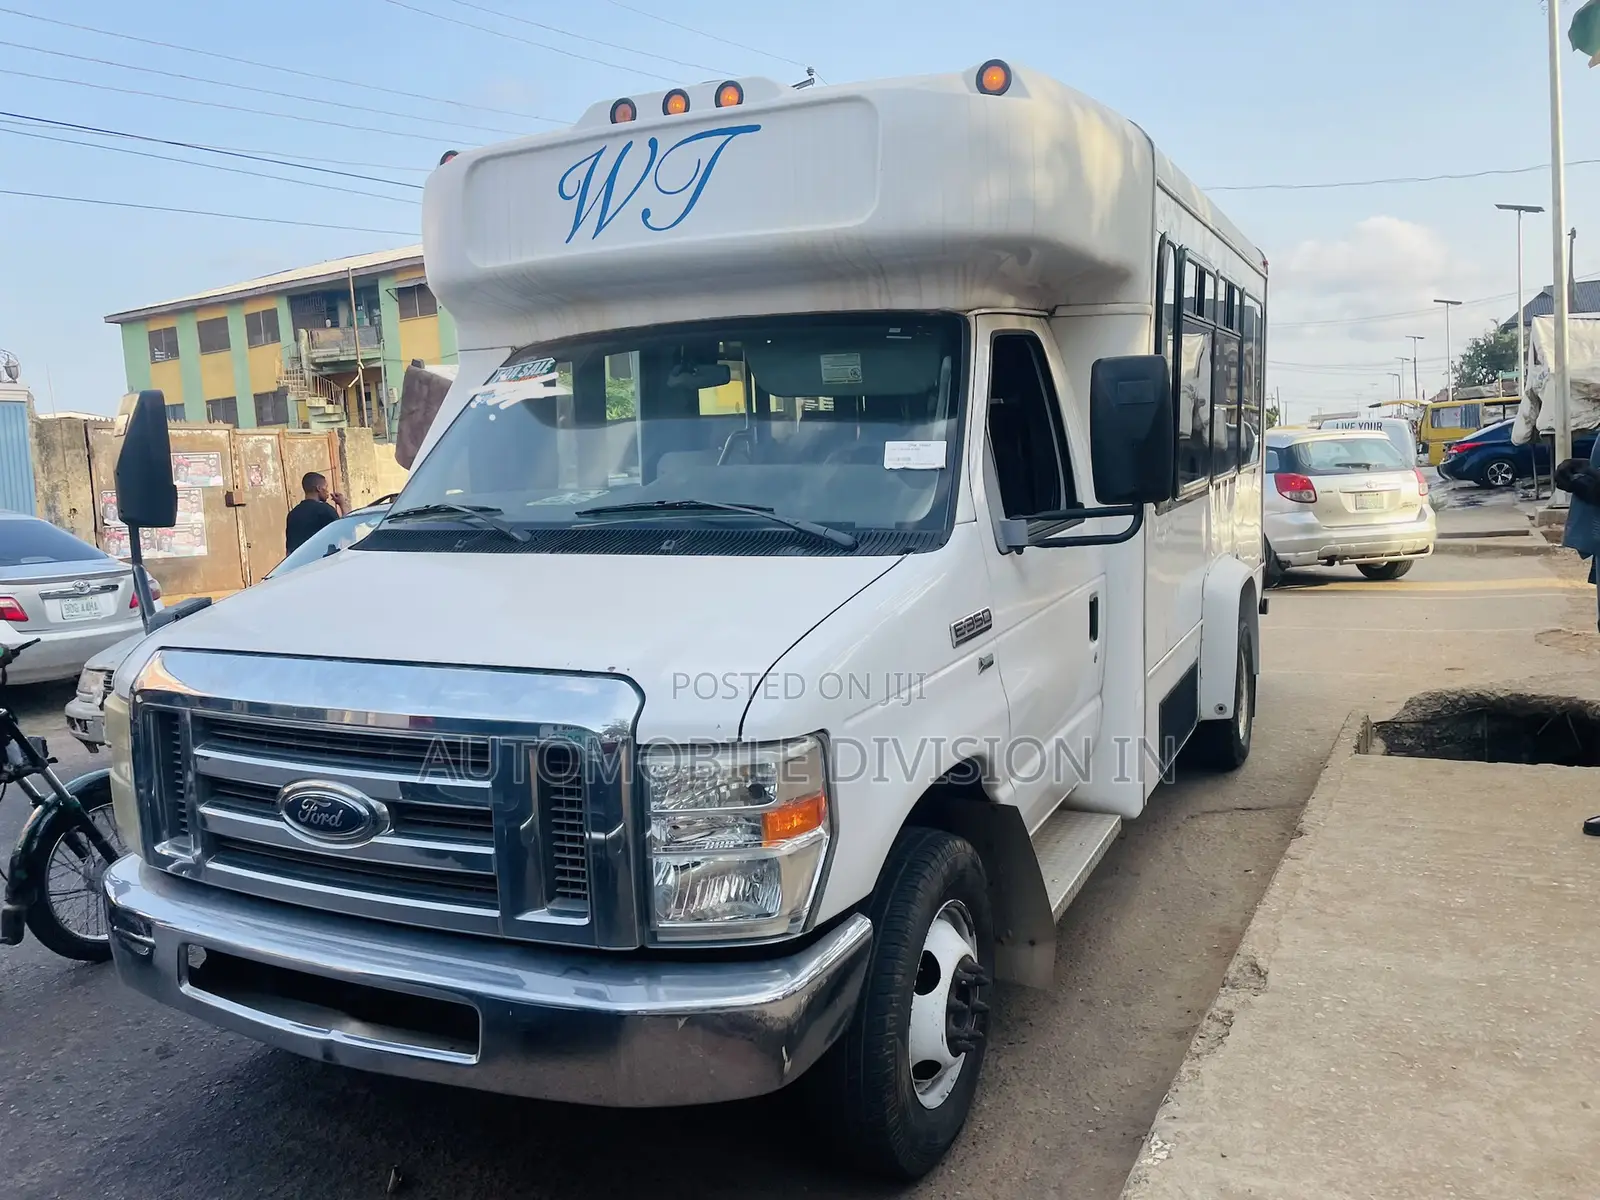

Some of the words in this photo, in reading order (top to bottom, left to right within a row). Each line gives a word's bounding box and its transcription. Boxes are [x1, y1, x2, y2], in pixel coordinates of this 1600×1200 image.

[558, 124, 761, 244] WT
[519, 360, 553, 377] SALE
[1358, 421, 1383, 431] YOUR
[298, 799, 343, 827] Ford
